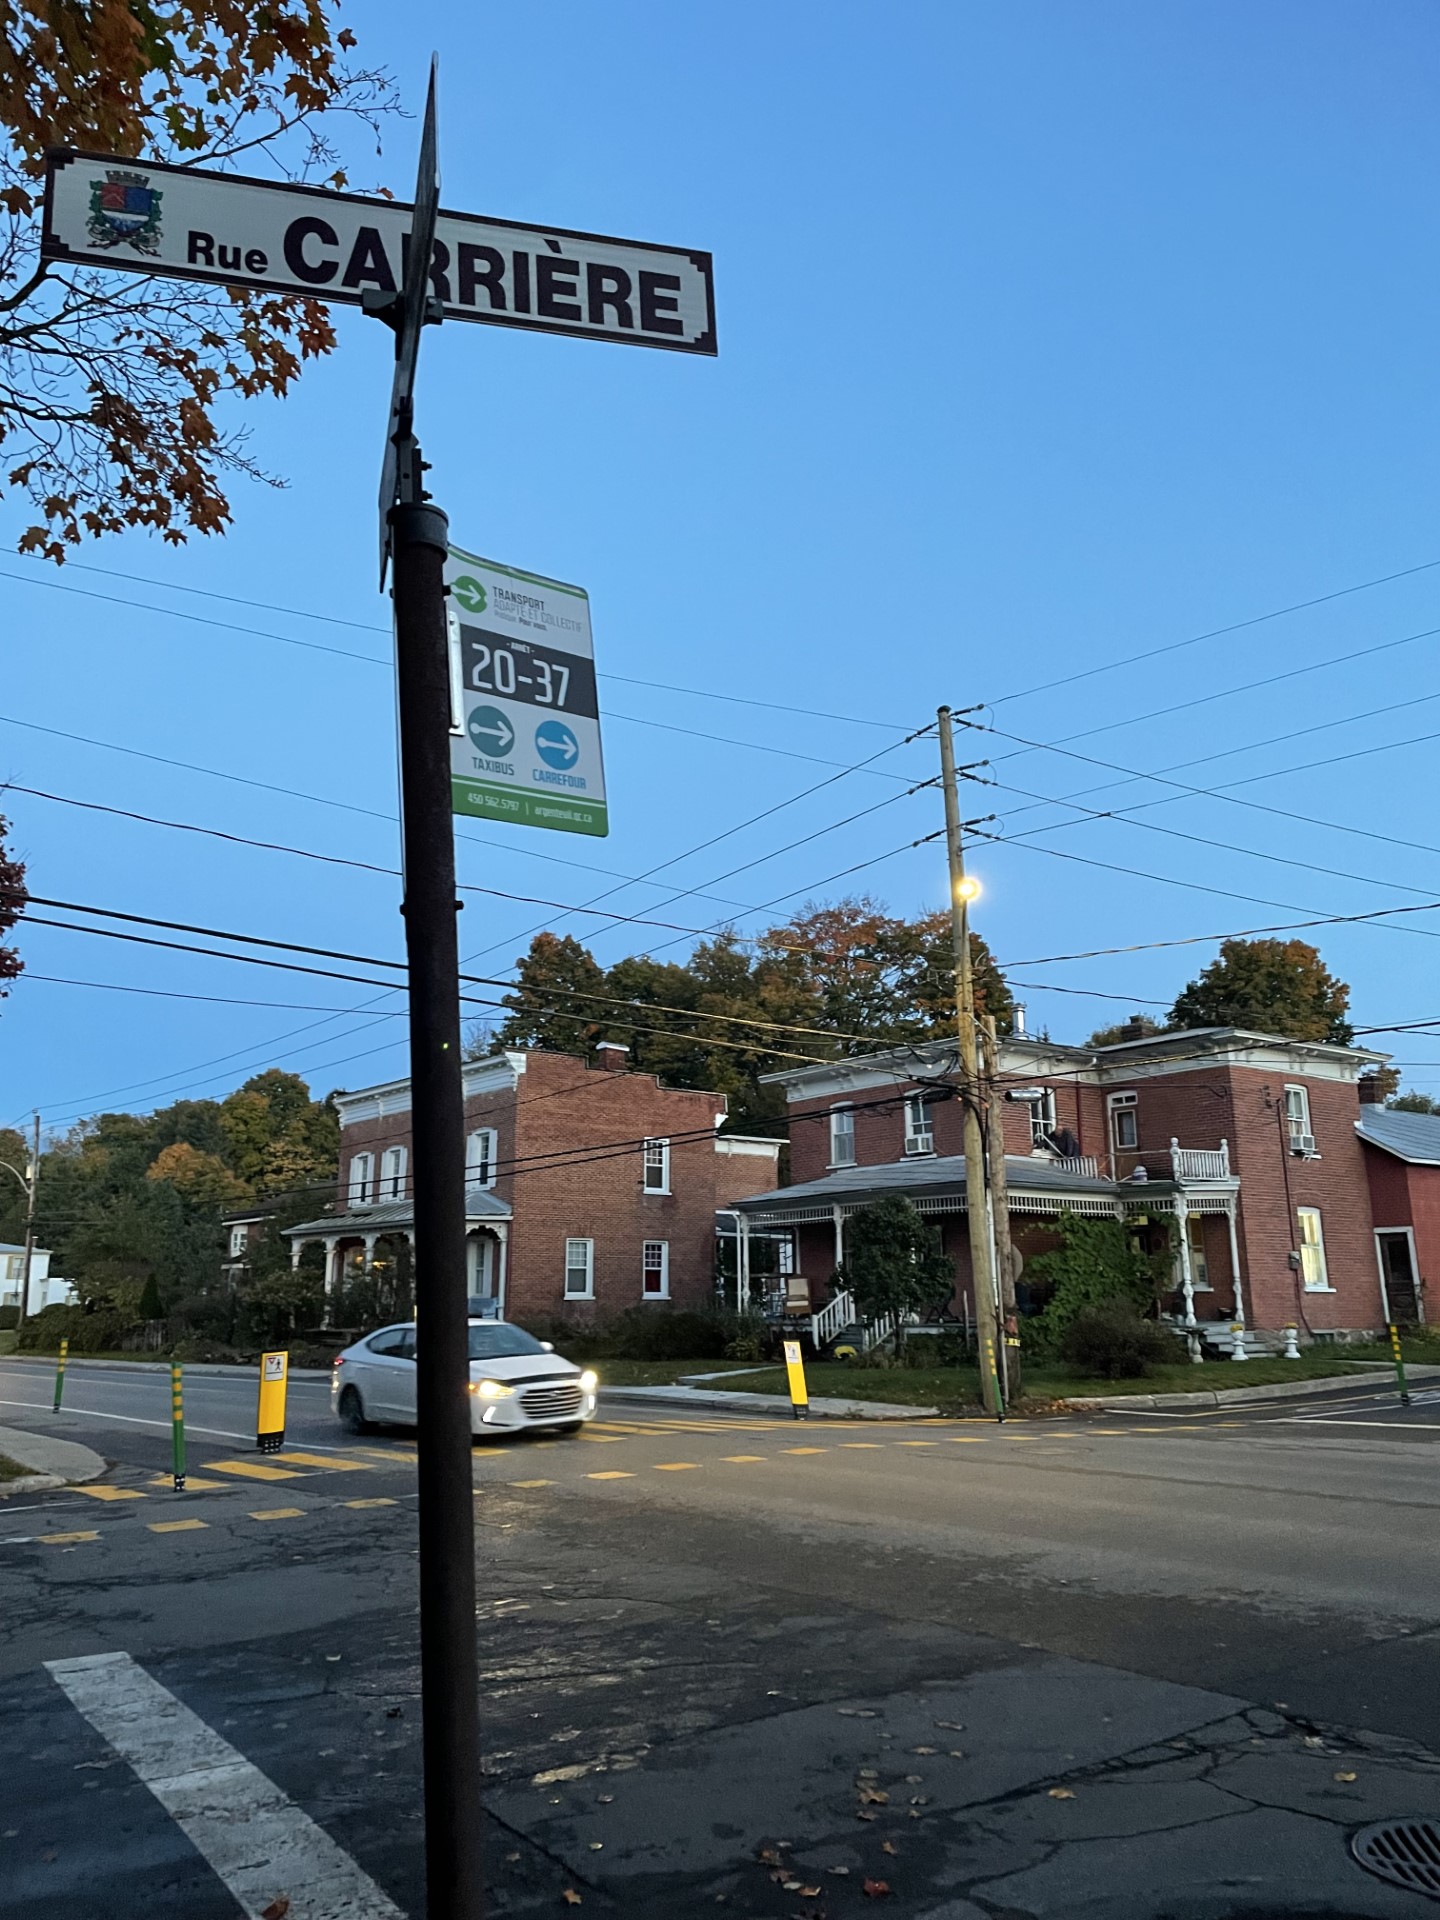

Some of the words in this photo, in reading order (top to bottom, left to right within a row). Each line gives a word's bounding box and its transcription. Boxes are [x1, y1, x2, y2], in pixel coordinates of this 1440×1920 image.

[187, 230, 269, 275] Rue
[283, 216, 685, 337] CARRIÈRE
[492, 586, 545, 611] TRANSPORT
[540, 611, 583, 633] COLLECTIF
[471, 642, 570, 707] 20-37
[472, 756, 515, 776] TAXIBUS
[532, 768, 587, 790] CARREFOUR
